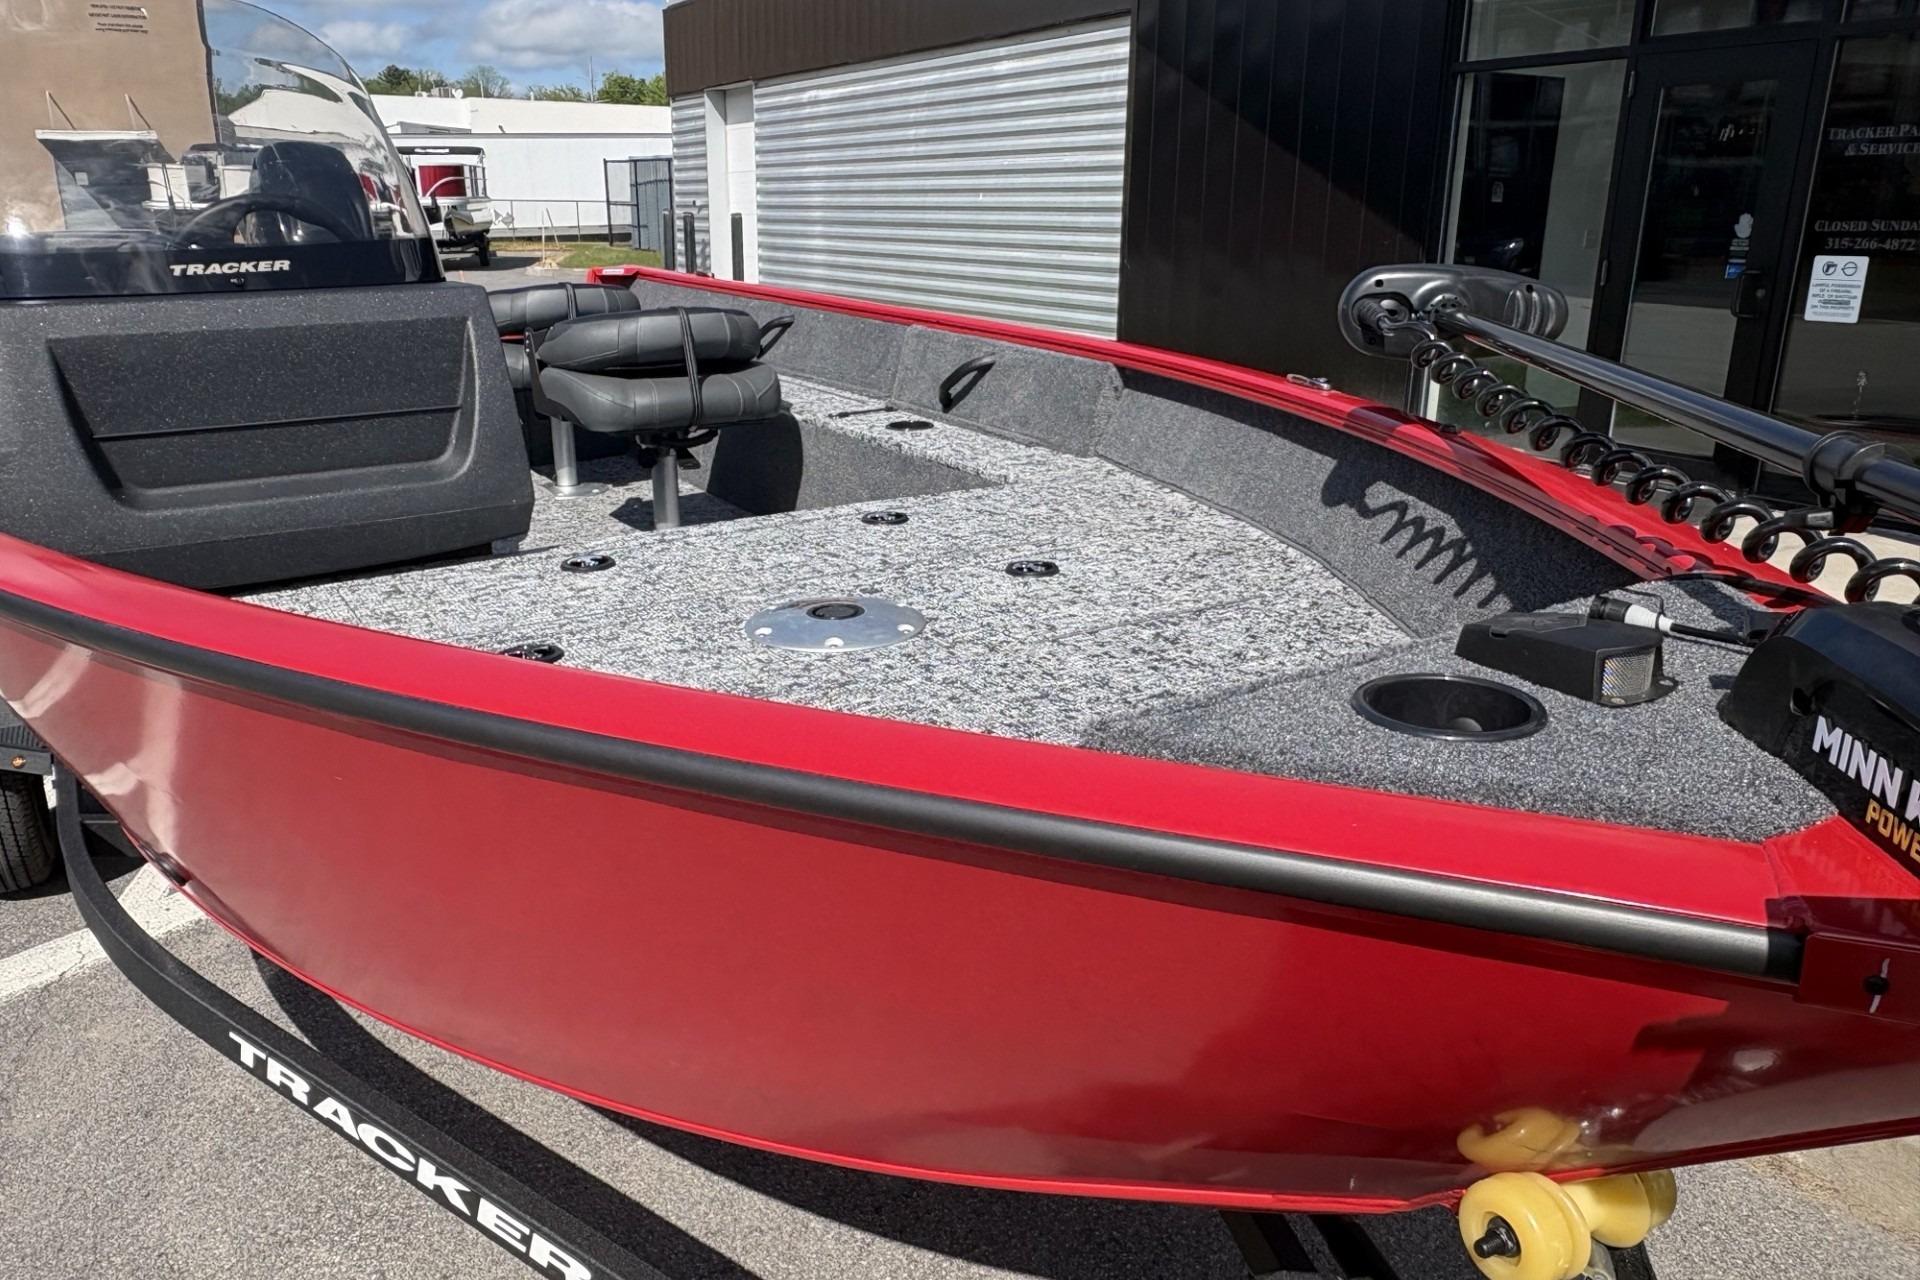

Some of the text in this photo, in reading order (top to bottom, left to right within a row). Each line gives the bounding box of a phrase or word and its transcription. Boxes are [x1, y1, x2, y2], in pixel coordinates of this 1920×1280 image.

[1827, 123, 1920, 140] TRACKER PA
[1844, 142, 1920, 156] & SERVICE
[1814, 218, 1920, 232] CLOSED SUNDA
[1824, 237, 1916, 251] 315-266-4872
[169, 259, 291, 276] TRACKER
[1812, 714, 1904, 809] MINN
[1865, 798, 1920, 864] POWE
[228, 1031, 592, 1280] TRACKER
